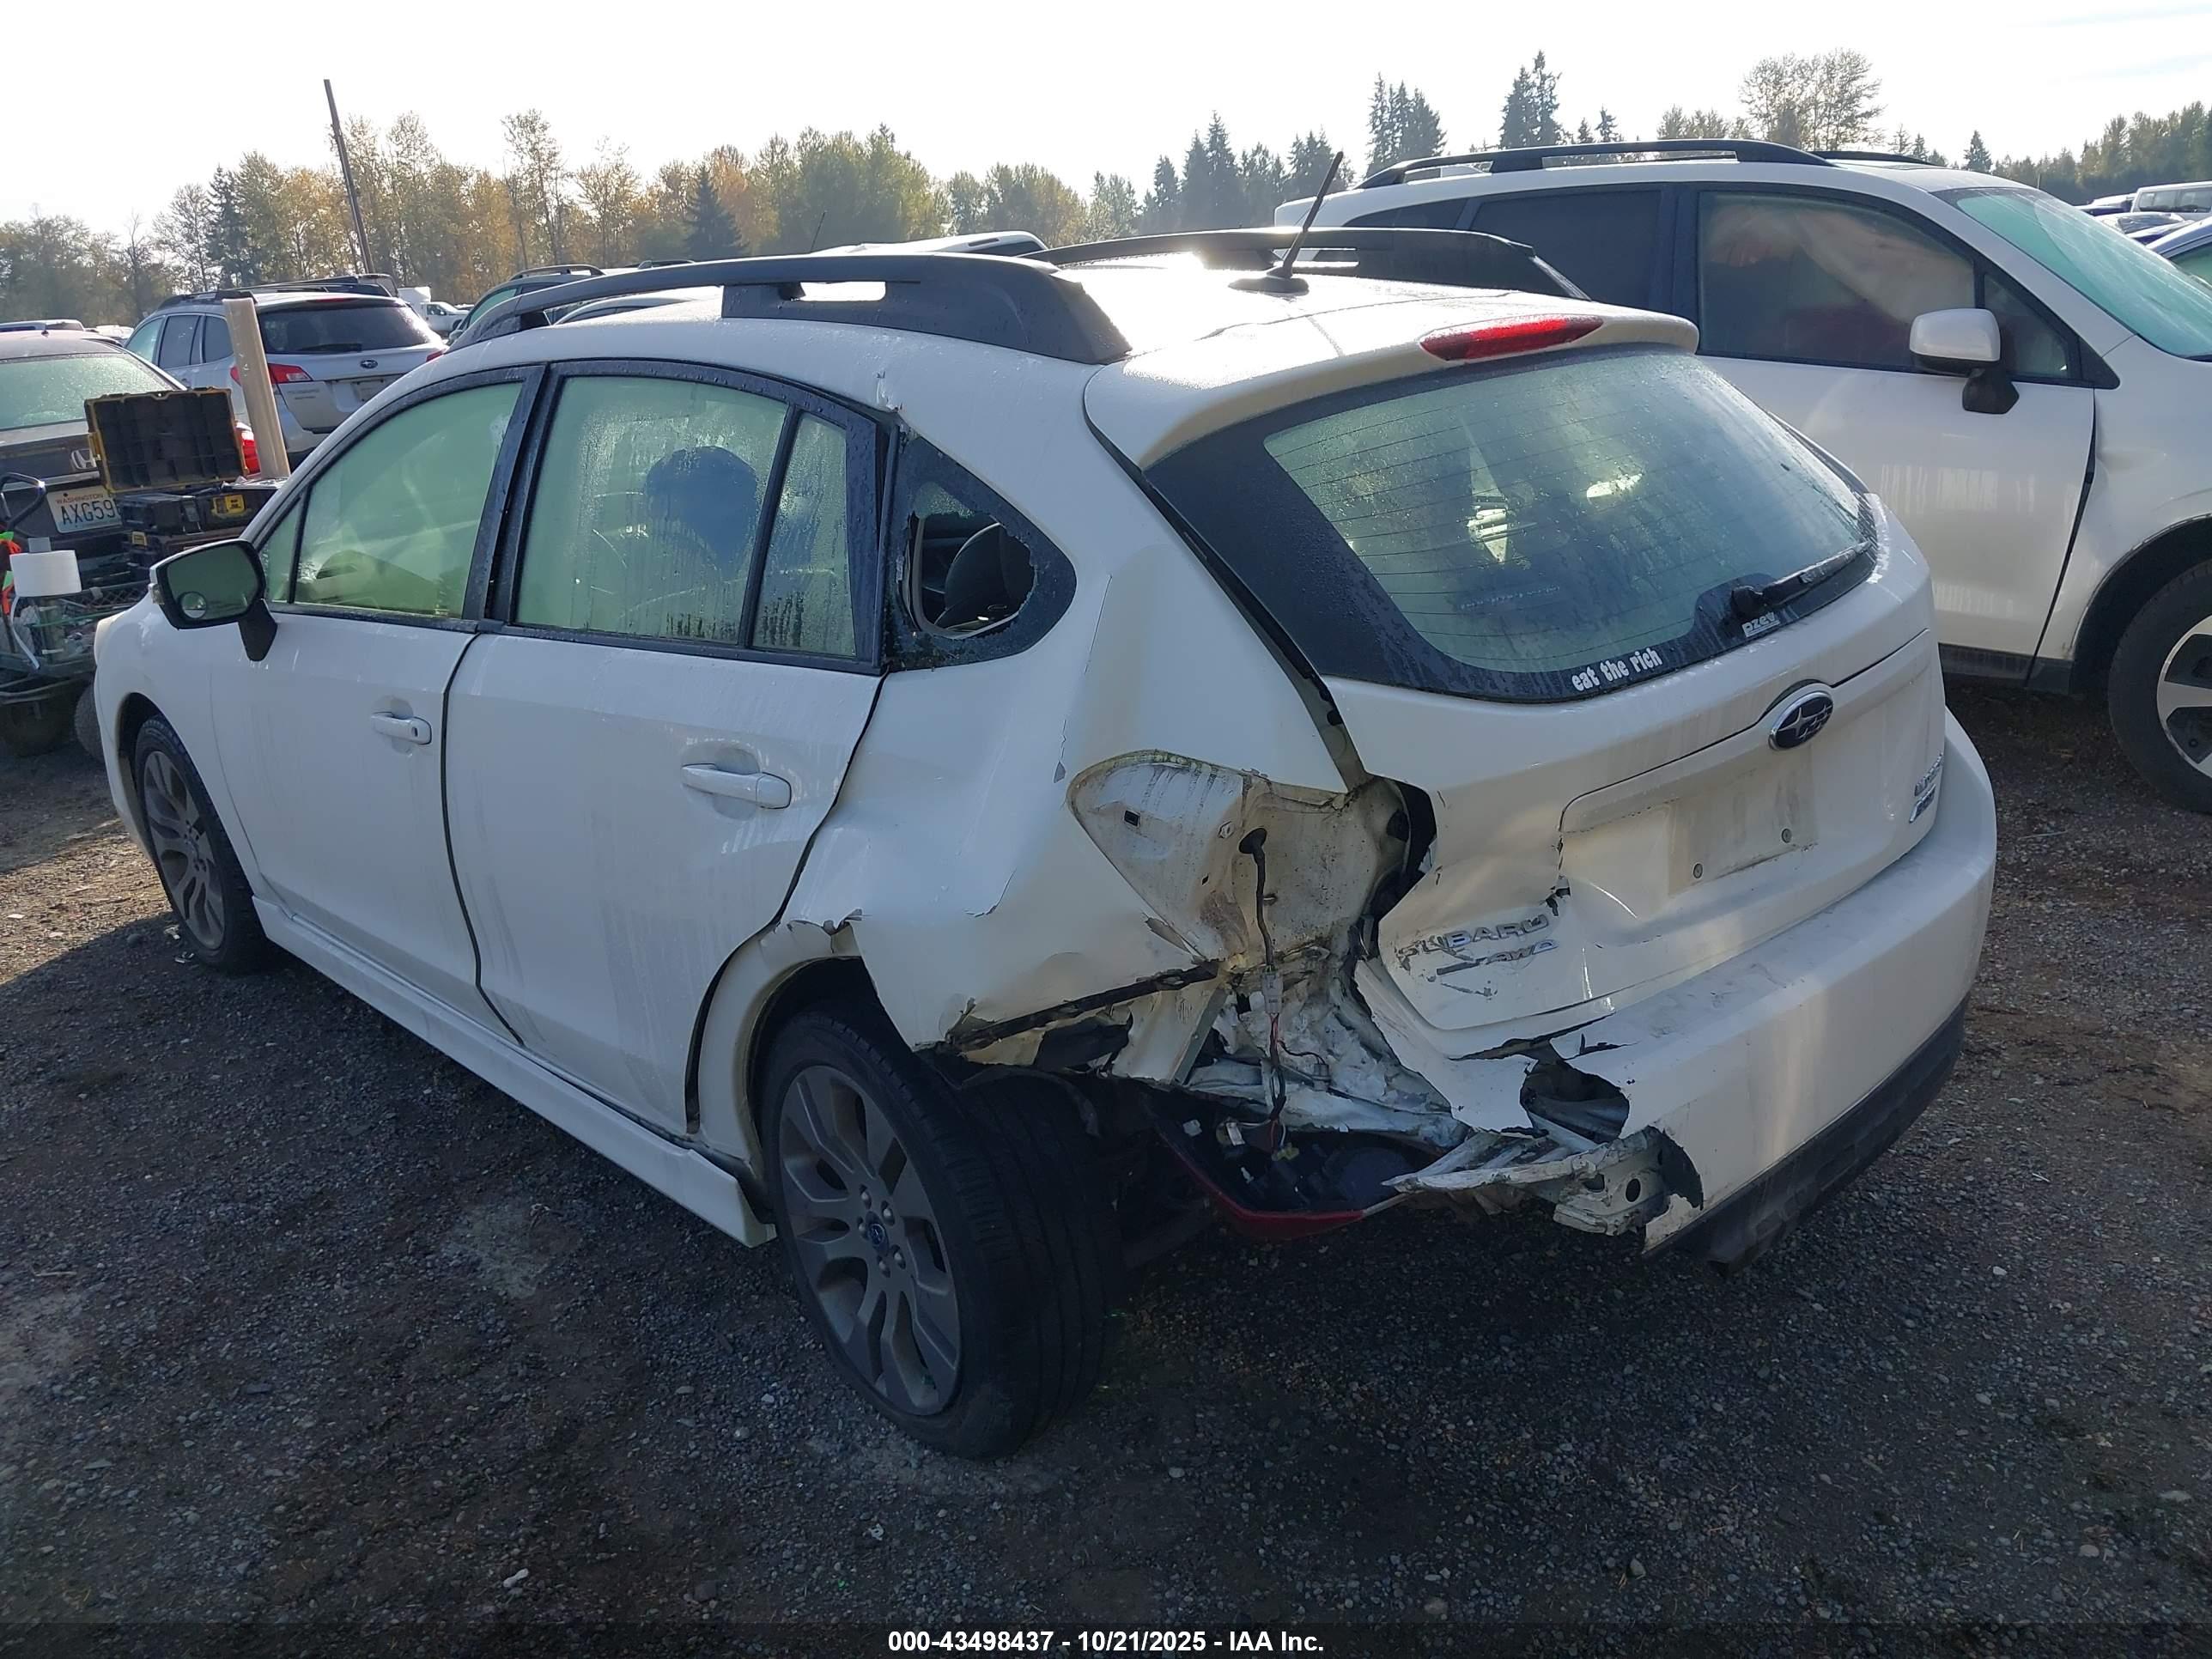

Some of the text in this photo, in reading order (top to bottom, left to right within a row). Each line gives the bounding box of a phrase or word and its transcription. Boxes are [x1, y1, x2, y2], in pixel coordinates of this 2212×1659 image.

[1571, 647, 1662, 691] eat the rich
